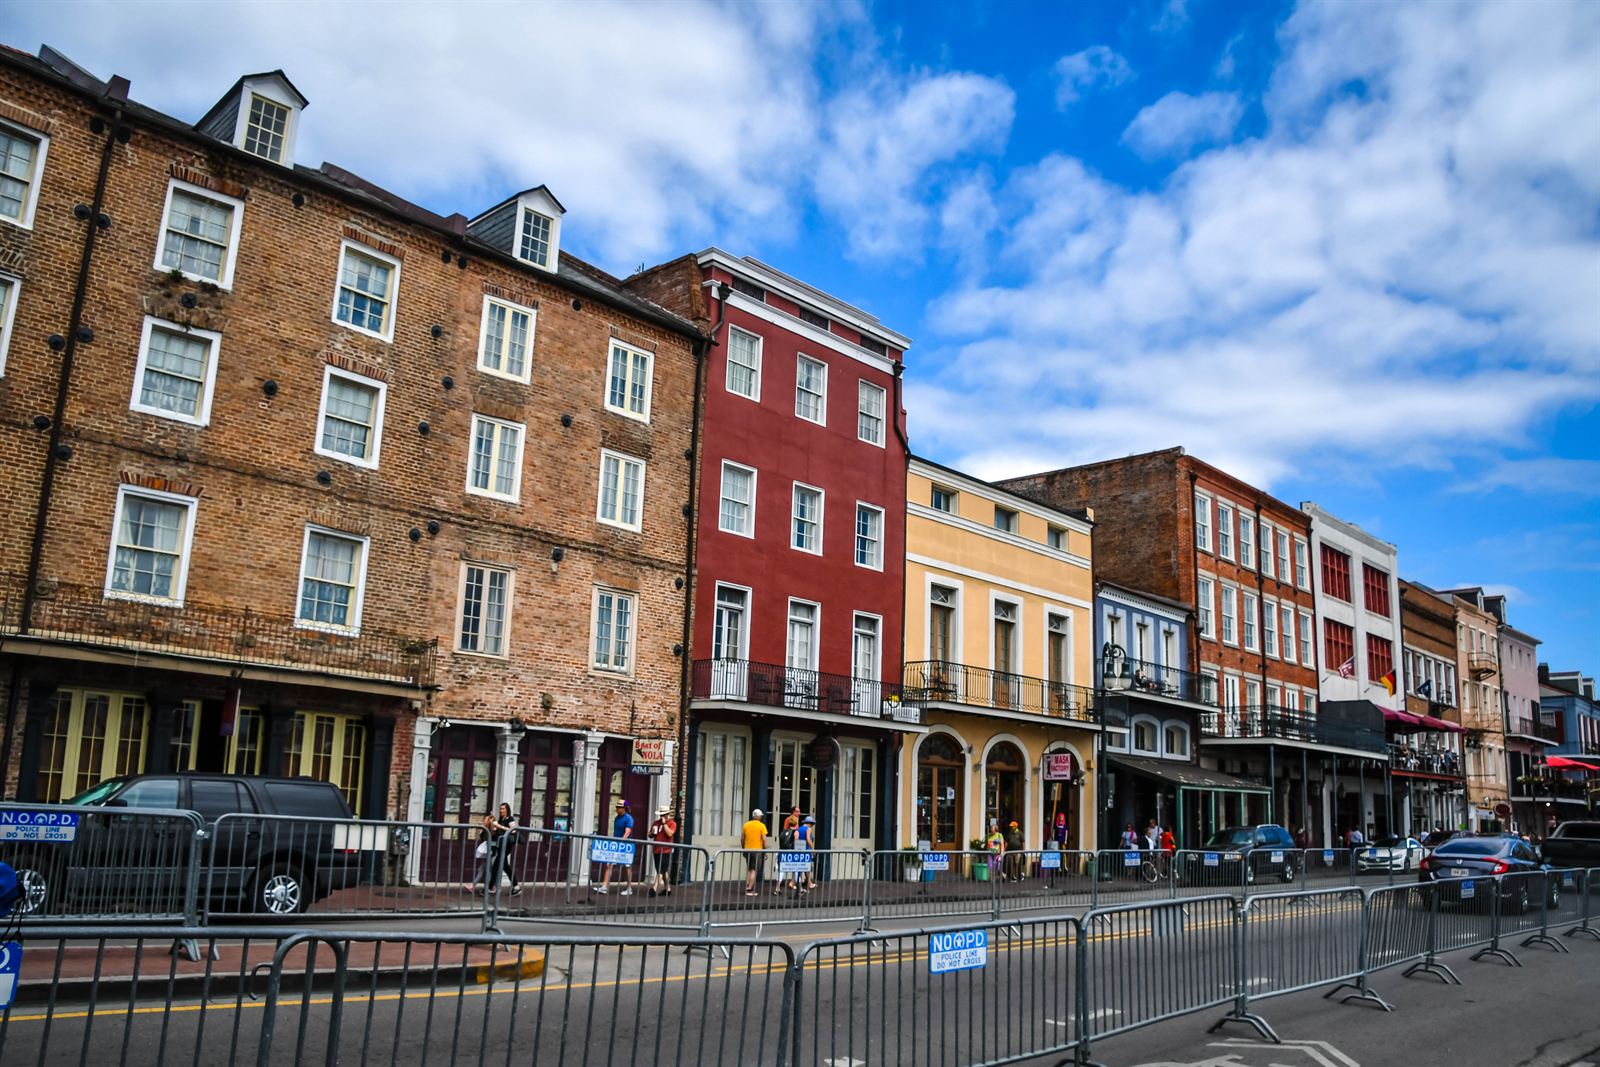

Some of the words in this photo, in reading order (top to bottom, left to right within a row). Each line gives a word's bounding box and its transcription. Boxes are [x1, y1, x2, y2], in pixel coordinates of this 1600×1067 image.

[654, 742, 662, 750] of
[1055, 755, 1069, 764] MASK
[941, 952, 961, 960] POLICE
[966, 950, 978, 958] LINE
[937, 961, 946, 969] DO
[964, 957, 981, 965] CROSS
